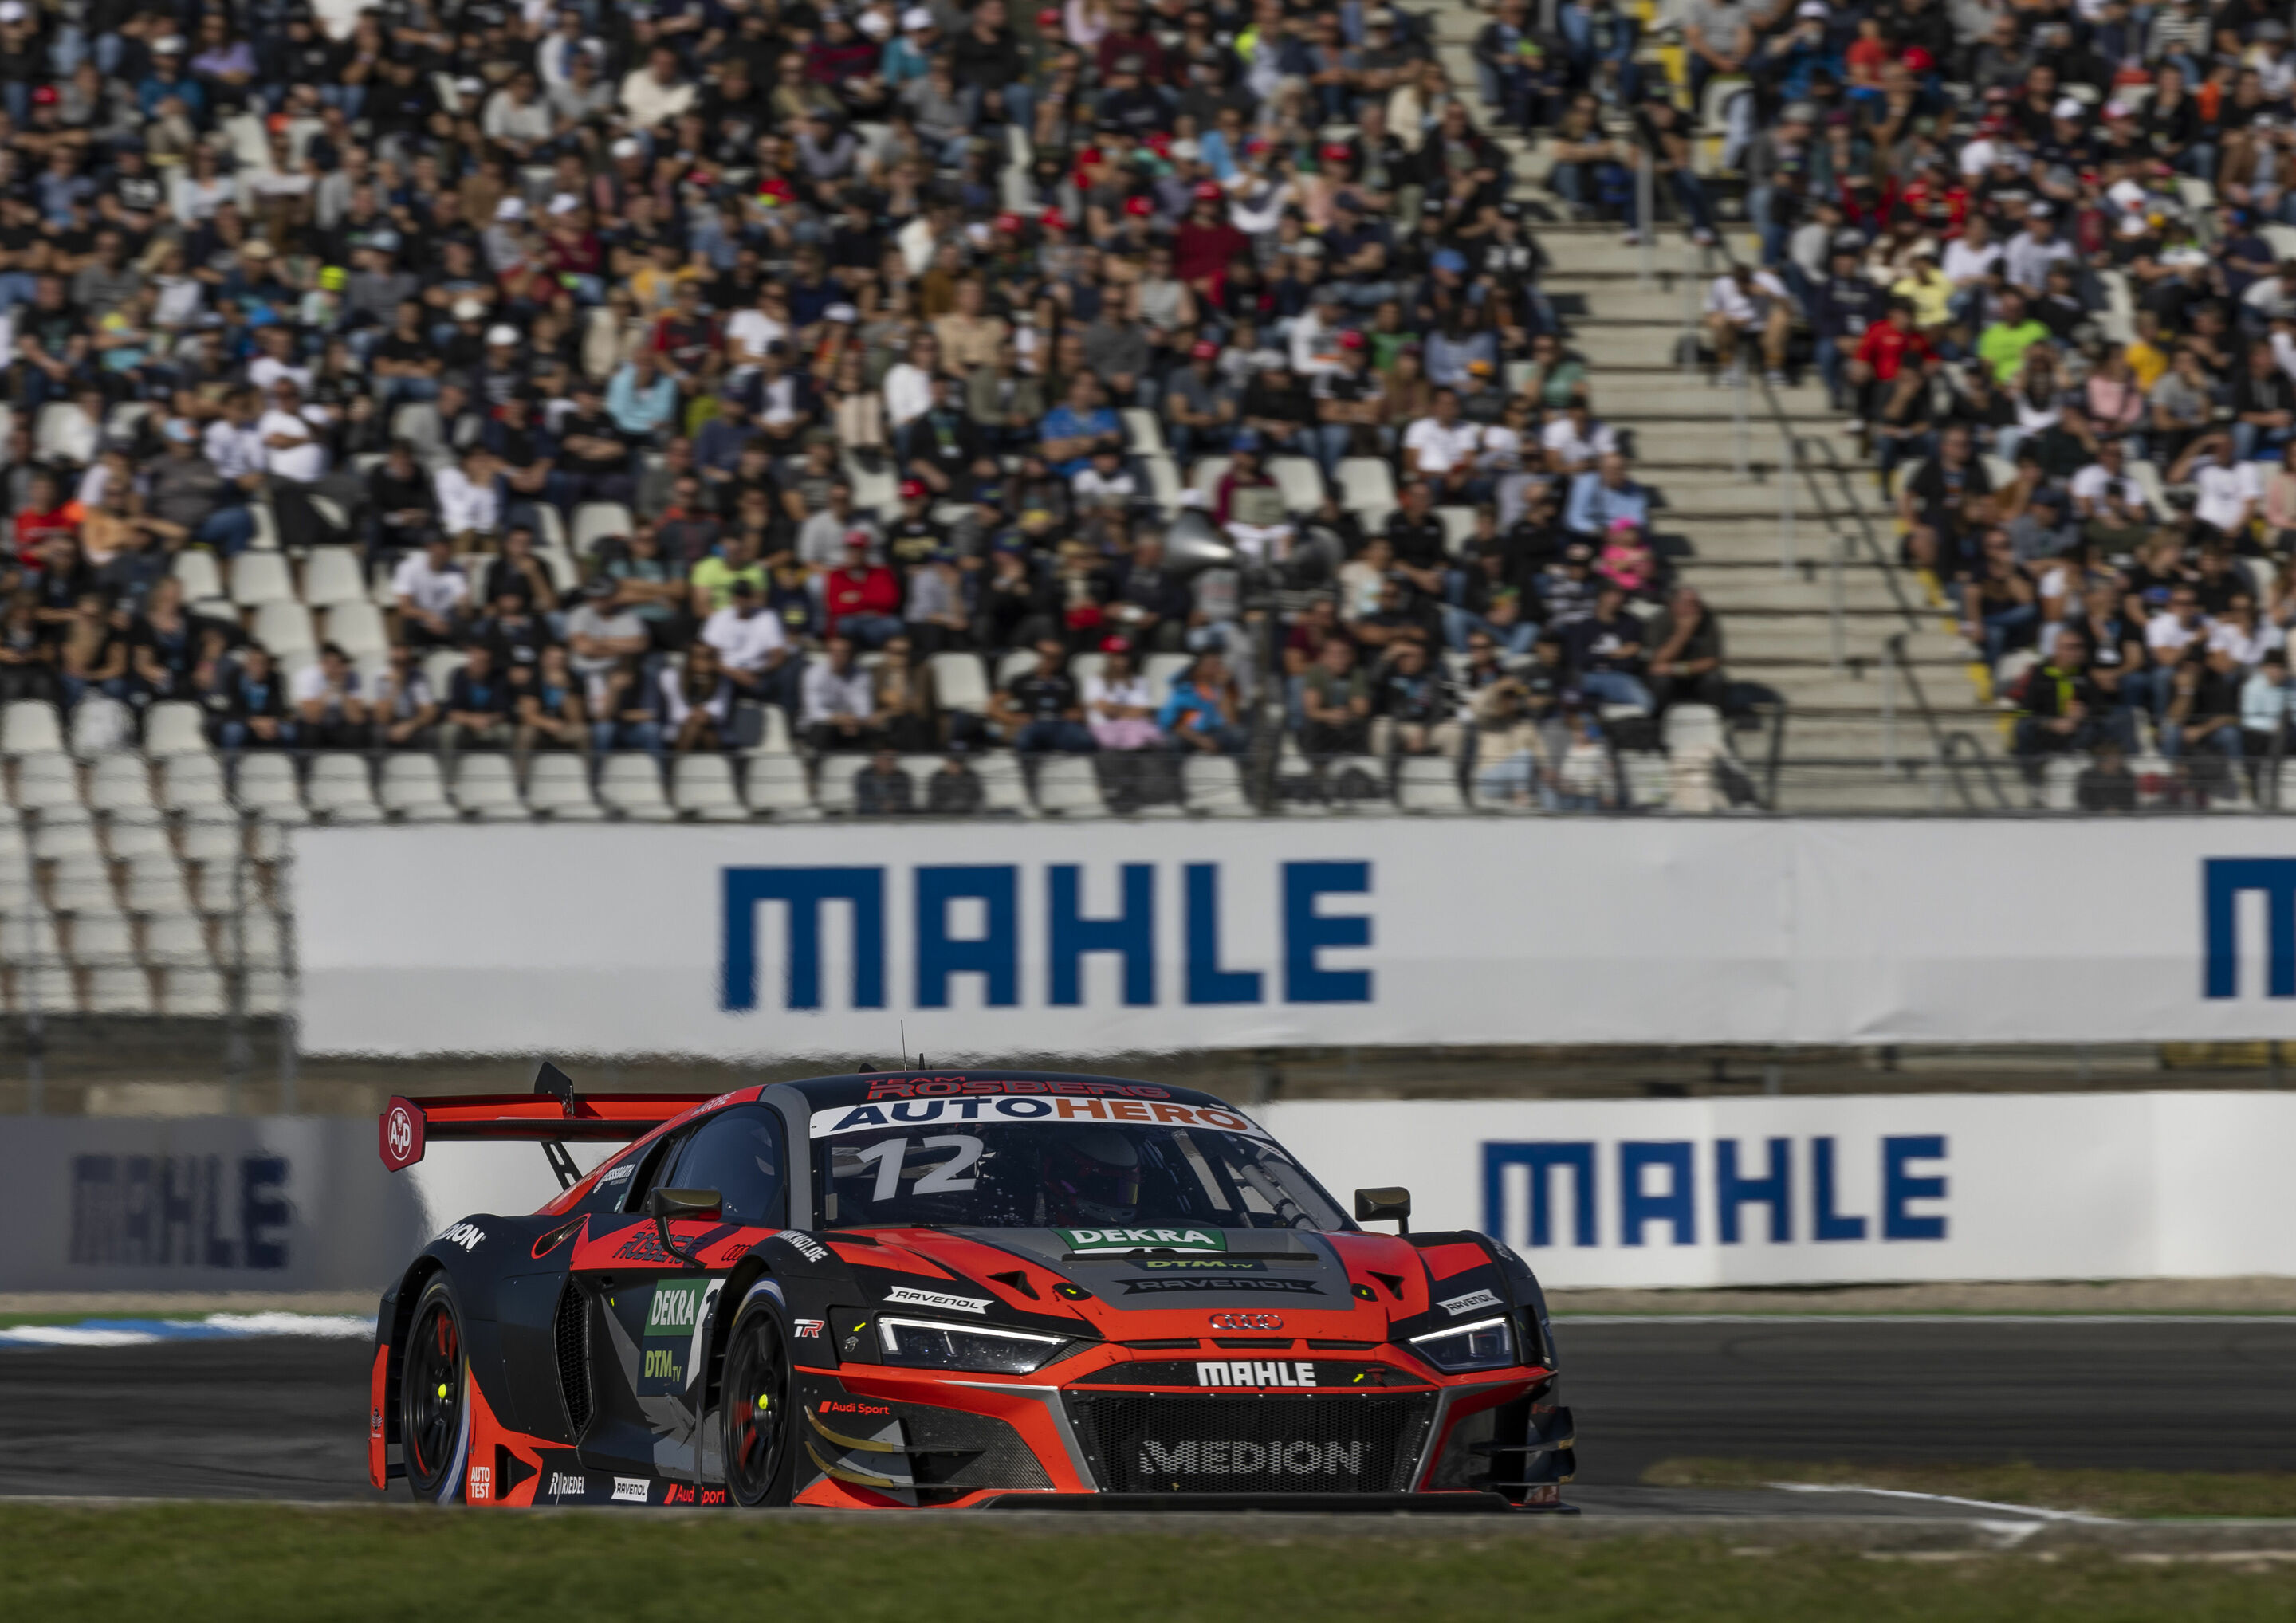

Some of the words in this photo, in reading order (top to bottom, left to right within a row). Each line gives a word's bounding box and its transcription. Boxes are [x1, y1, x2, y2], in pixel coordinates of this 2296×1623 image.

[721, 860, 1374, 1011] MAHLE
[865, 1076, 966, 1086] TEAM
[867, 1080, 1171, 1100] ROSBERG
[830, 1098, 1248, 1131] AUTOHERO
[856, 1134, 985, 1202] 12
[1481, 1135, 1948, 1247] MAHLE
[1069, 1229, 1216, 1244] DEKRA
[1135, 1279, 1307, 1291] RAVENOL
[651, 1289, 696, 1326] DEKRA
[895, 1291, 979, 1309] RAVENOL
[1445, 1292, 1495, 1311] RAVENOL
[794, 1318, 825, 1338] TR
[644, 1350, 673, 1377] DTM
[672, 1366, 682, 1382] TV
[1196, 1362, 1316, 1387] MAHLE
[832, 1402, 855, 1412] Audi
[858, 1403, 890, 1415] Sport
[1139, 1440, 1364, 1475] MEDION
[470, 1467, 490, 1482] AUTO
[470, 1483, 490, 1499] TEST
[561, 1476, 585, 1495] RIEDEL
[616, 1483, 647, 1496] RAVENOL
[676, 1485, 695, 1502] Aud
